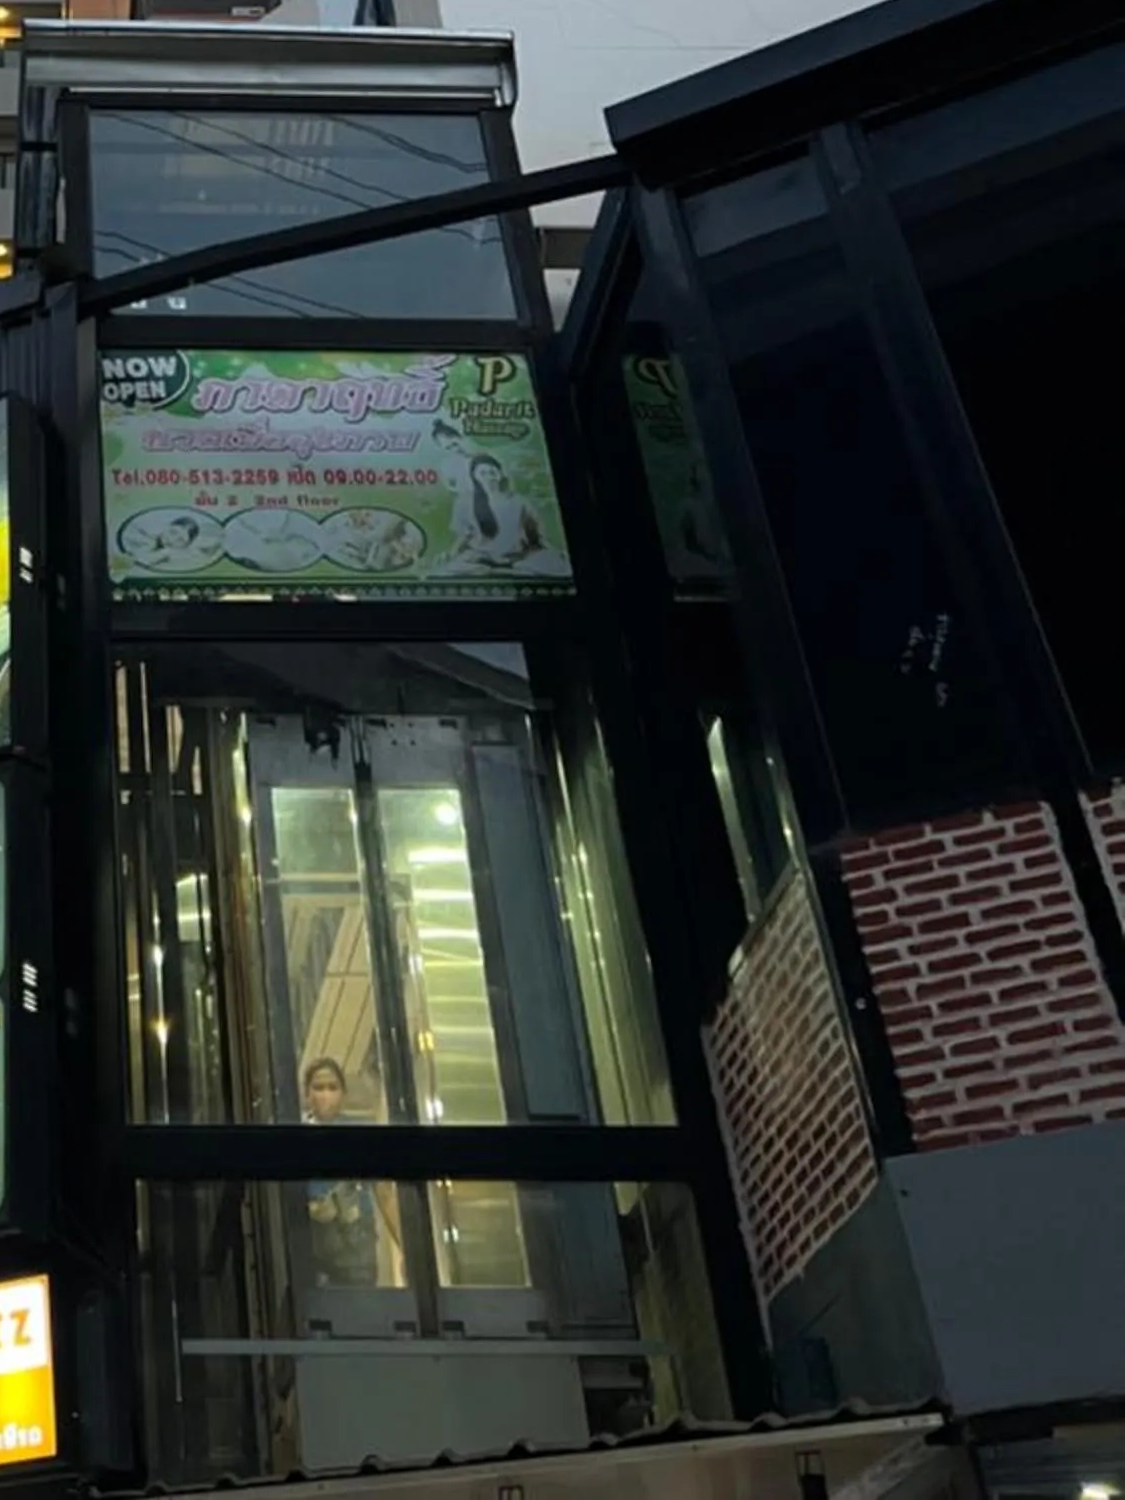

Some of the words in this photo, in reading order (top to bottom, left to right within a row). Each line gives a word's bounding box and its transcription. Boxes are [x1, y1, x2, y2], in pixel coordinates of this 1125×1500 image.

[102, 356, 176, 379] NOW
[102, 380, 167, 401] OPEN
[323, 468, 439, 486] 09.00-22.00
